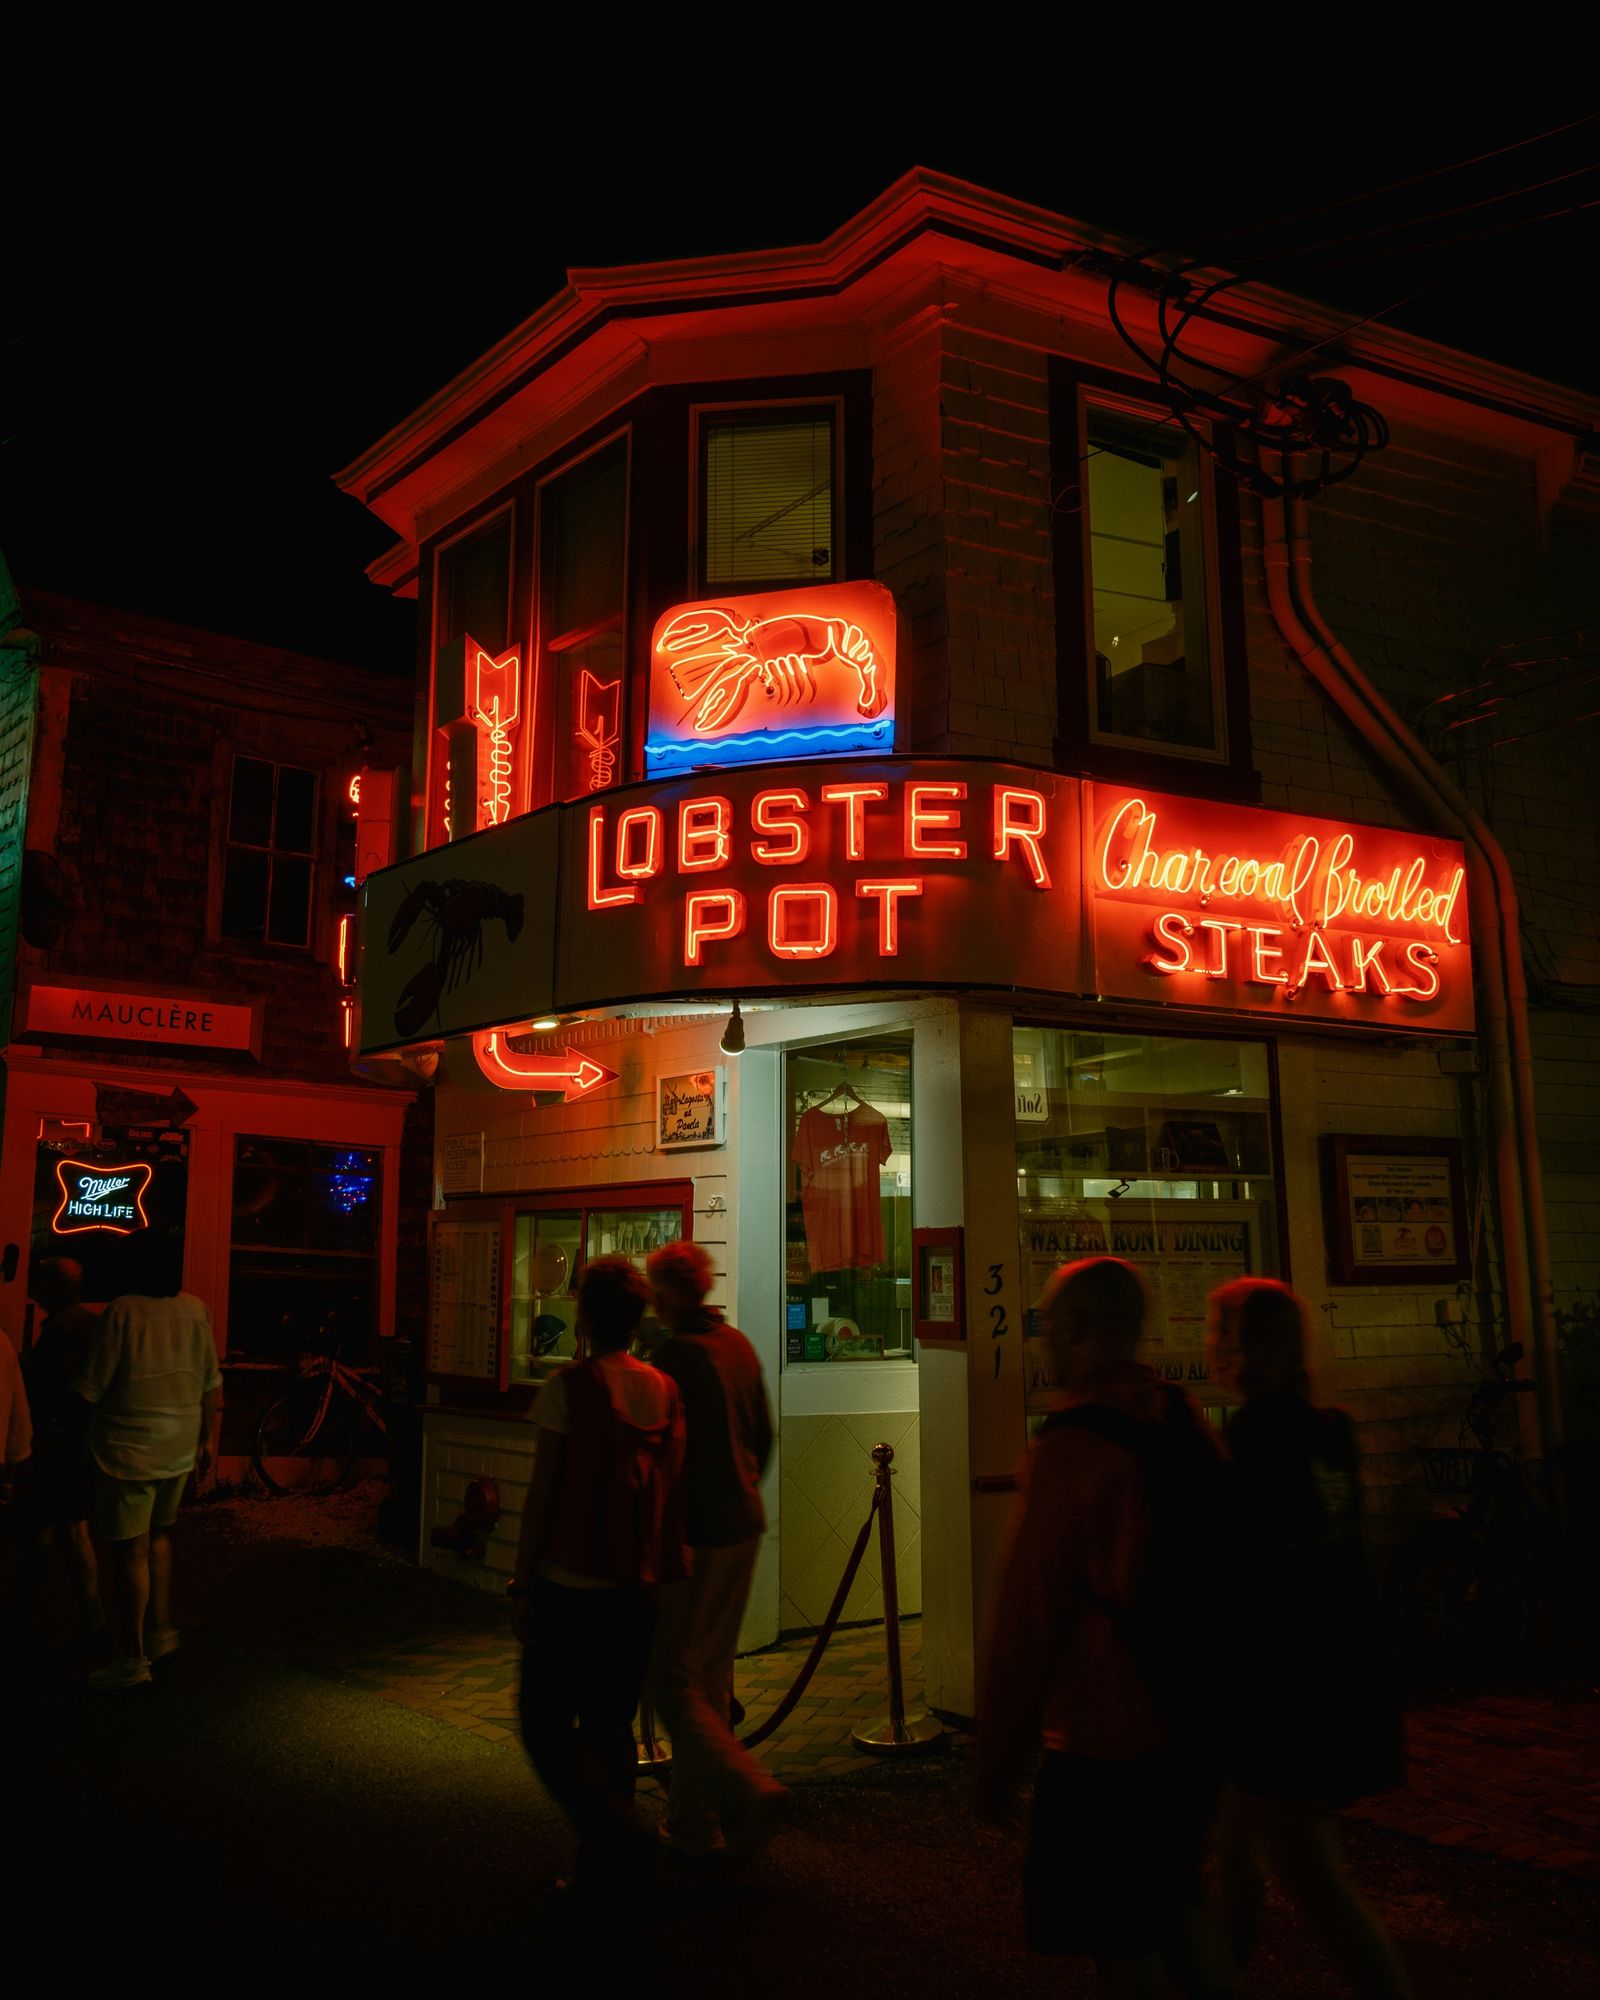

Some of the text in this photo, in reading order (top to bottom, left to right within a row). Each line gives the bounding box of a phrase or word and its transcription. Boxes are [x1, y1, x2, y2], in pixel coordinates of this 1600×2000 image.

[587, 780, 1053, 911] LOBSTER
[683, 878, 924, 967] POT
[1142, 912, 1441, 1001] STEAKS
[71, 999, 214, 1033] MAUCLÈRE
[79, 1176, 131, 1200] Miller
[67, 1200, 134, 1219] HIGH LIFE
[1174, 1224, 1244, 1251] DINING
